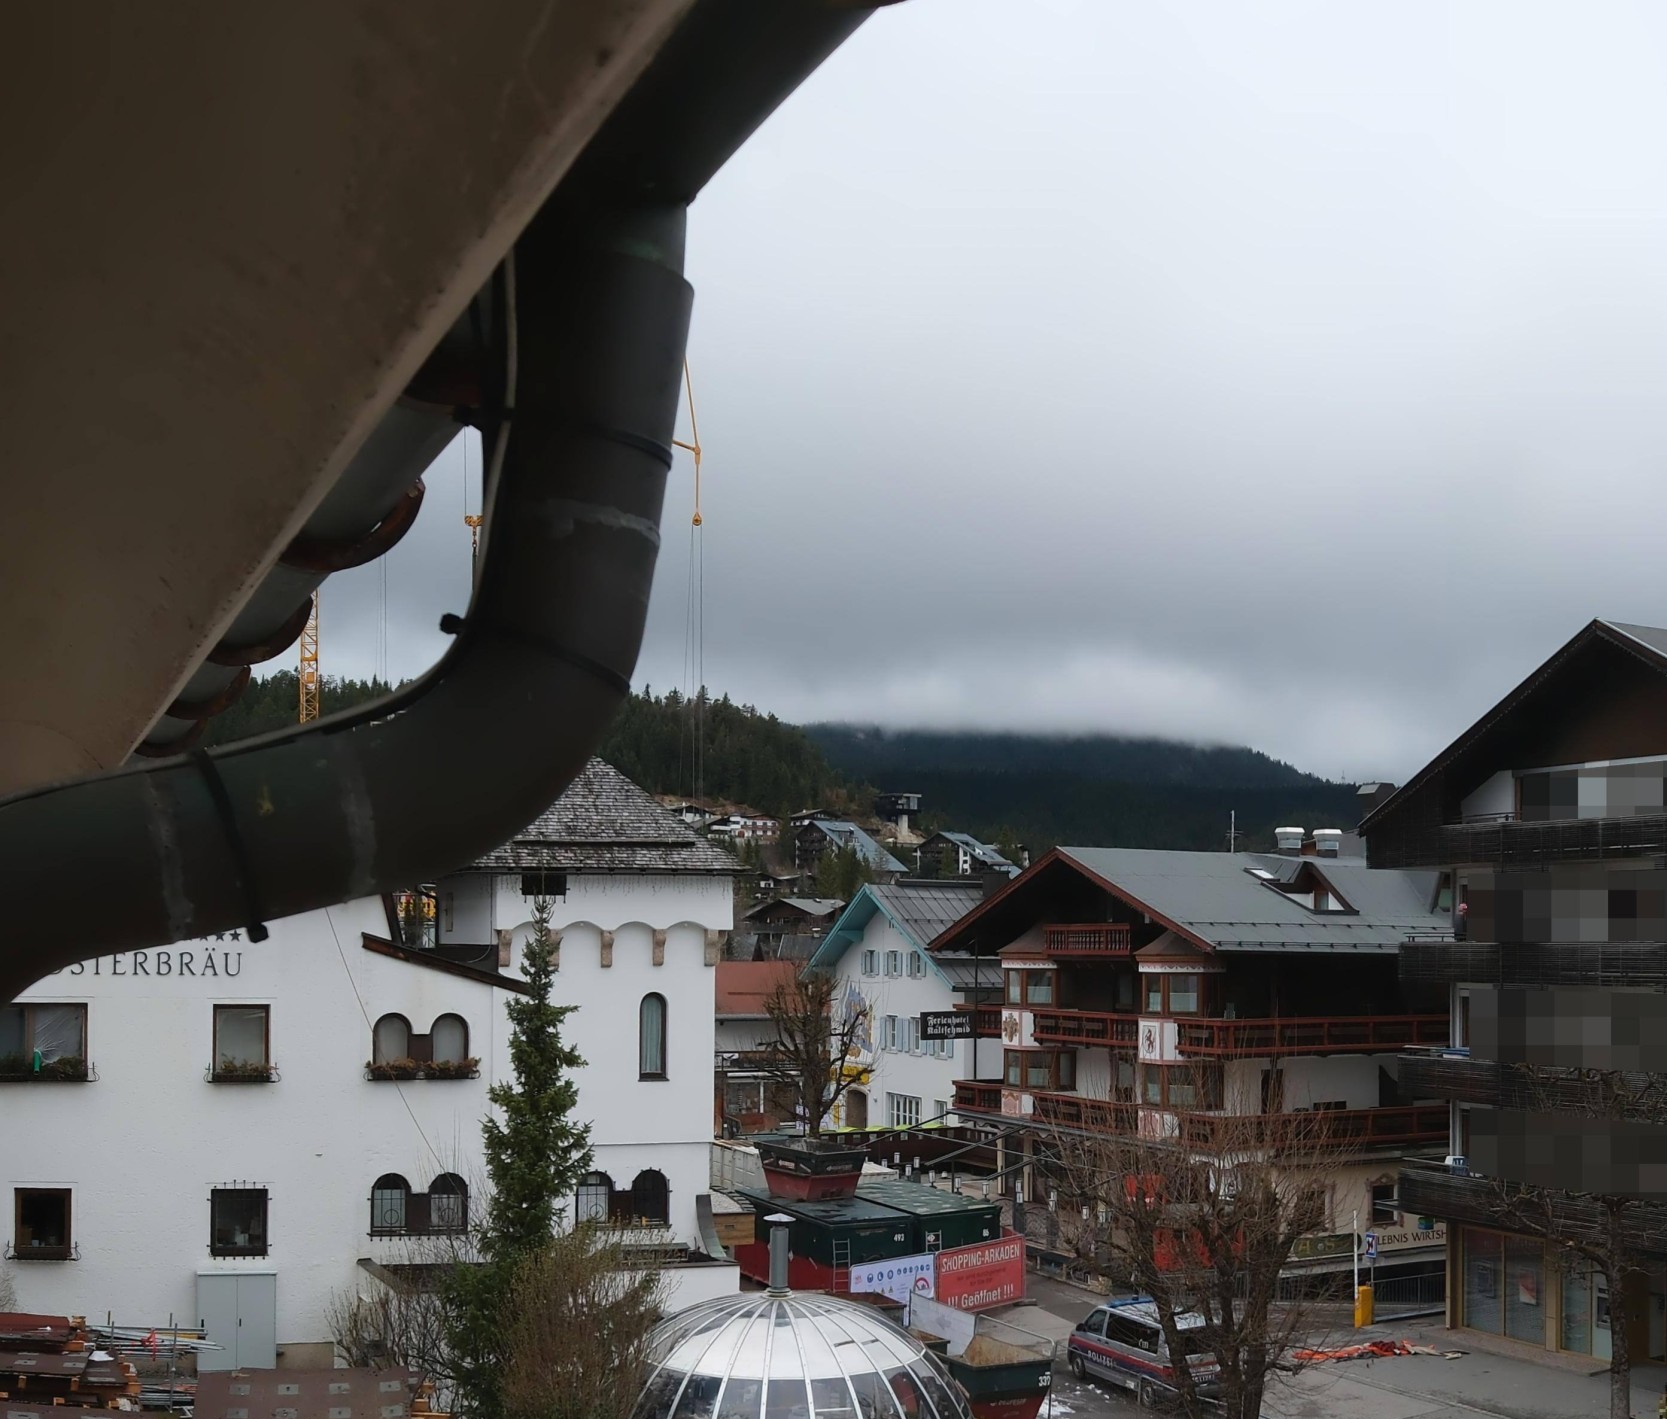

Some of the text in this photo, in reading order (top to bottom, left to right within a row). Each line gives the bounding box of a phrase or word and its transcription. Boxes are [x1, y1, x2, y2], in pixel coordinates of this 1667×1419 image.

[50, 948, 243, 977] STERBRÄU
[941, 1243, 1020, 1272] SHOPPING-ARKADEN
[961, 1288, 1001, 1308] Geöffnet
[1087, 1350, 1114, 1368] POLIZEI
